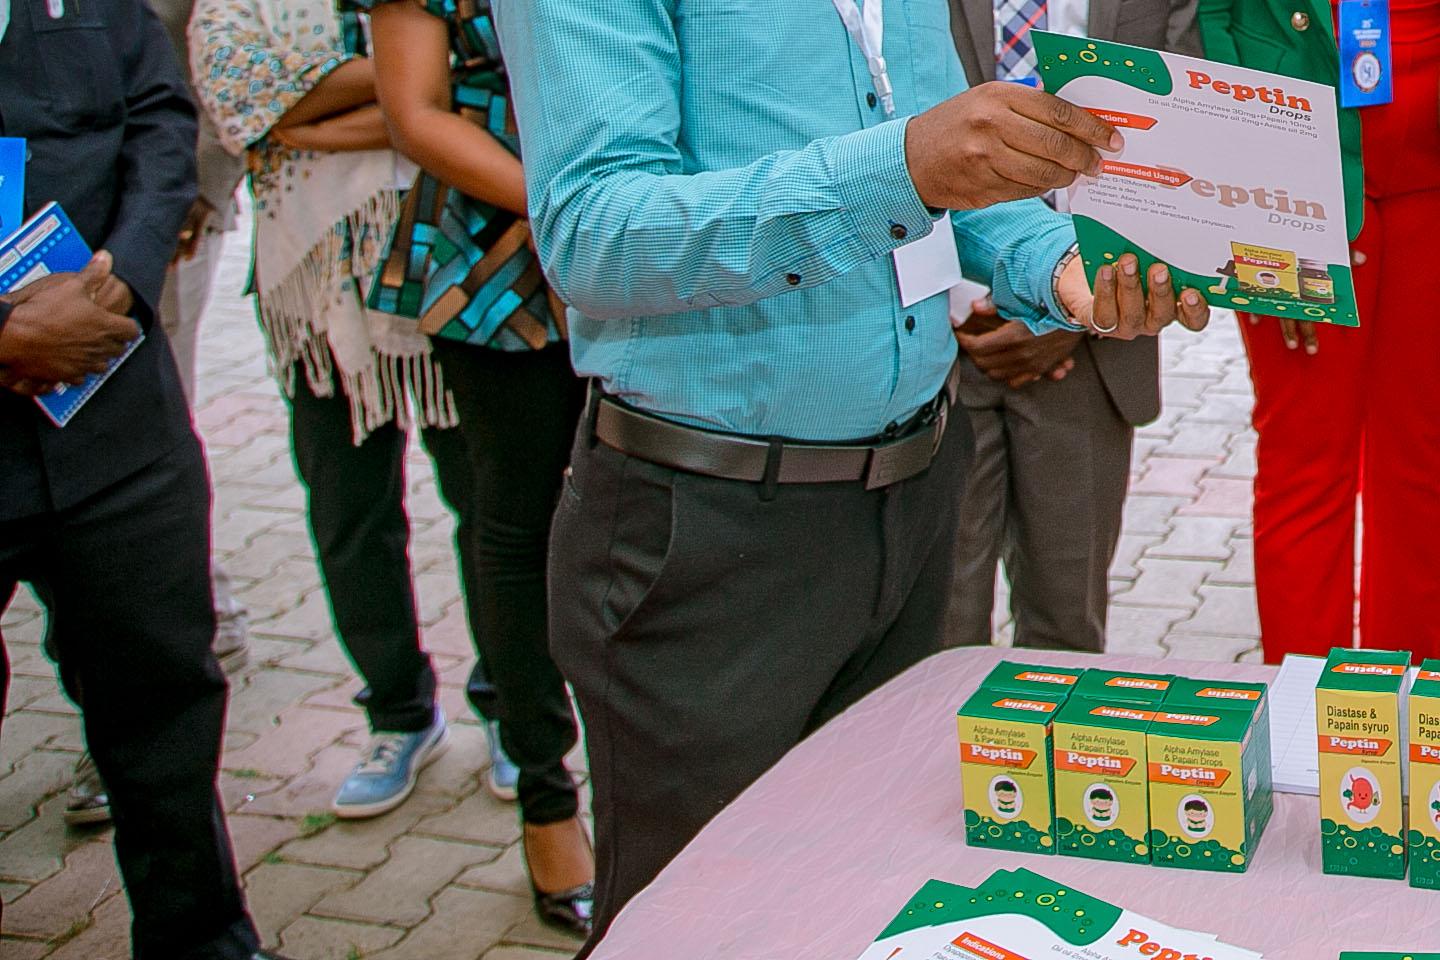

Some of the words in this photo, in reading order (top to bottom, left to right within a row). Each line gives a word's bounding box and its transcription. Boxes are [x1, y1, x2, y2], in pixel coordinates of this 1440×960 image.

[1186, 70, 1313, 112] Peptin
[1173, 97, 1196, 106] Alpha
[1197, 102, 1231, 113] Amylase
[1270, 106, 1312, 122] Drops
[1300, 129, 1318, 139] 2mg
[1153, 172, 1180, 183] Usage
[1268, 213, 1326, 233] Drops
[1344, 666, 1392, 675] Peptin
[1026, 674, 1067, 684] Peptin
[1117, 679, 1158, 689] Peptin
[1207, 690, 1250, 699] Peptin
[1004, 700, 1045, 711] Peptin
[1327, 705, 1367, 719] Diastase
[1370, 708, 1377, 719] &
[1101, 709, 1144, 720] Peptin
[1166, 713, 1209, 722] Peptin
[973, 725, 994, 735] Alpha
[995, 728, 1026, 739] Amylase
[1327, 718, 1360, 733] Papain
[1362, 723, 1389, 734] syrup
[1008, 739, 1030, 748] Drops
[1070, 733, 1092, 743] Alpha
[1093, 736, 1125, 746] Amylase
[1330, 736, 1379, 751] Peptin
[970, 745, 1023, 760] Peptin
[1071, 742, 1077, 750] &
[1078, 743, 1105, 754] Papain
[1106, 746, 1129, 756] Drops
[1164, 745, 1186, 755] Alpha
[1187, 747, 1220, 757] Amylase
[1067, 752, 1122, 768] Peptin
[1164, 754, 1171, 762] &
[1172, 754, 1198, 765] Papain
[1199, 757, 1223, 767] Drops
[1160, 764, 1216, 781] Peptin
[961, 937, 1006, 960] Indications
